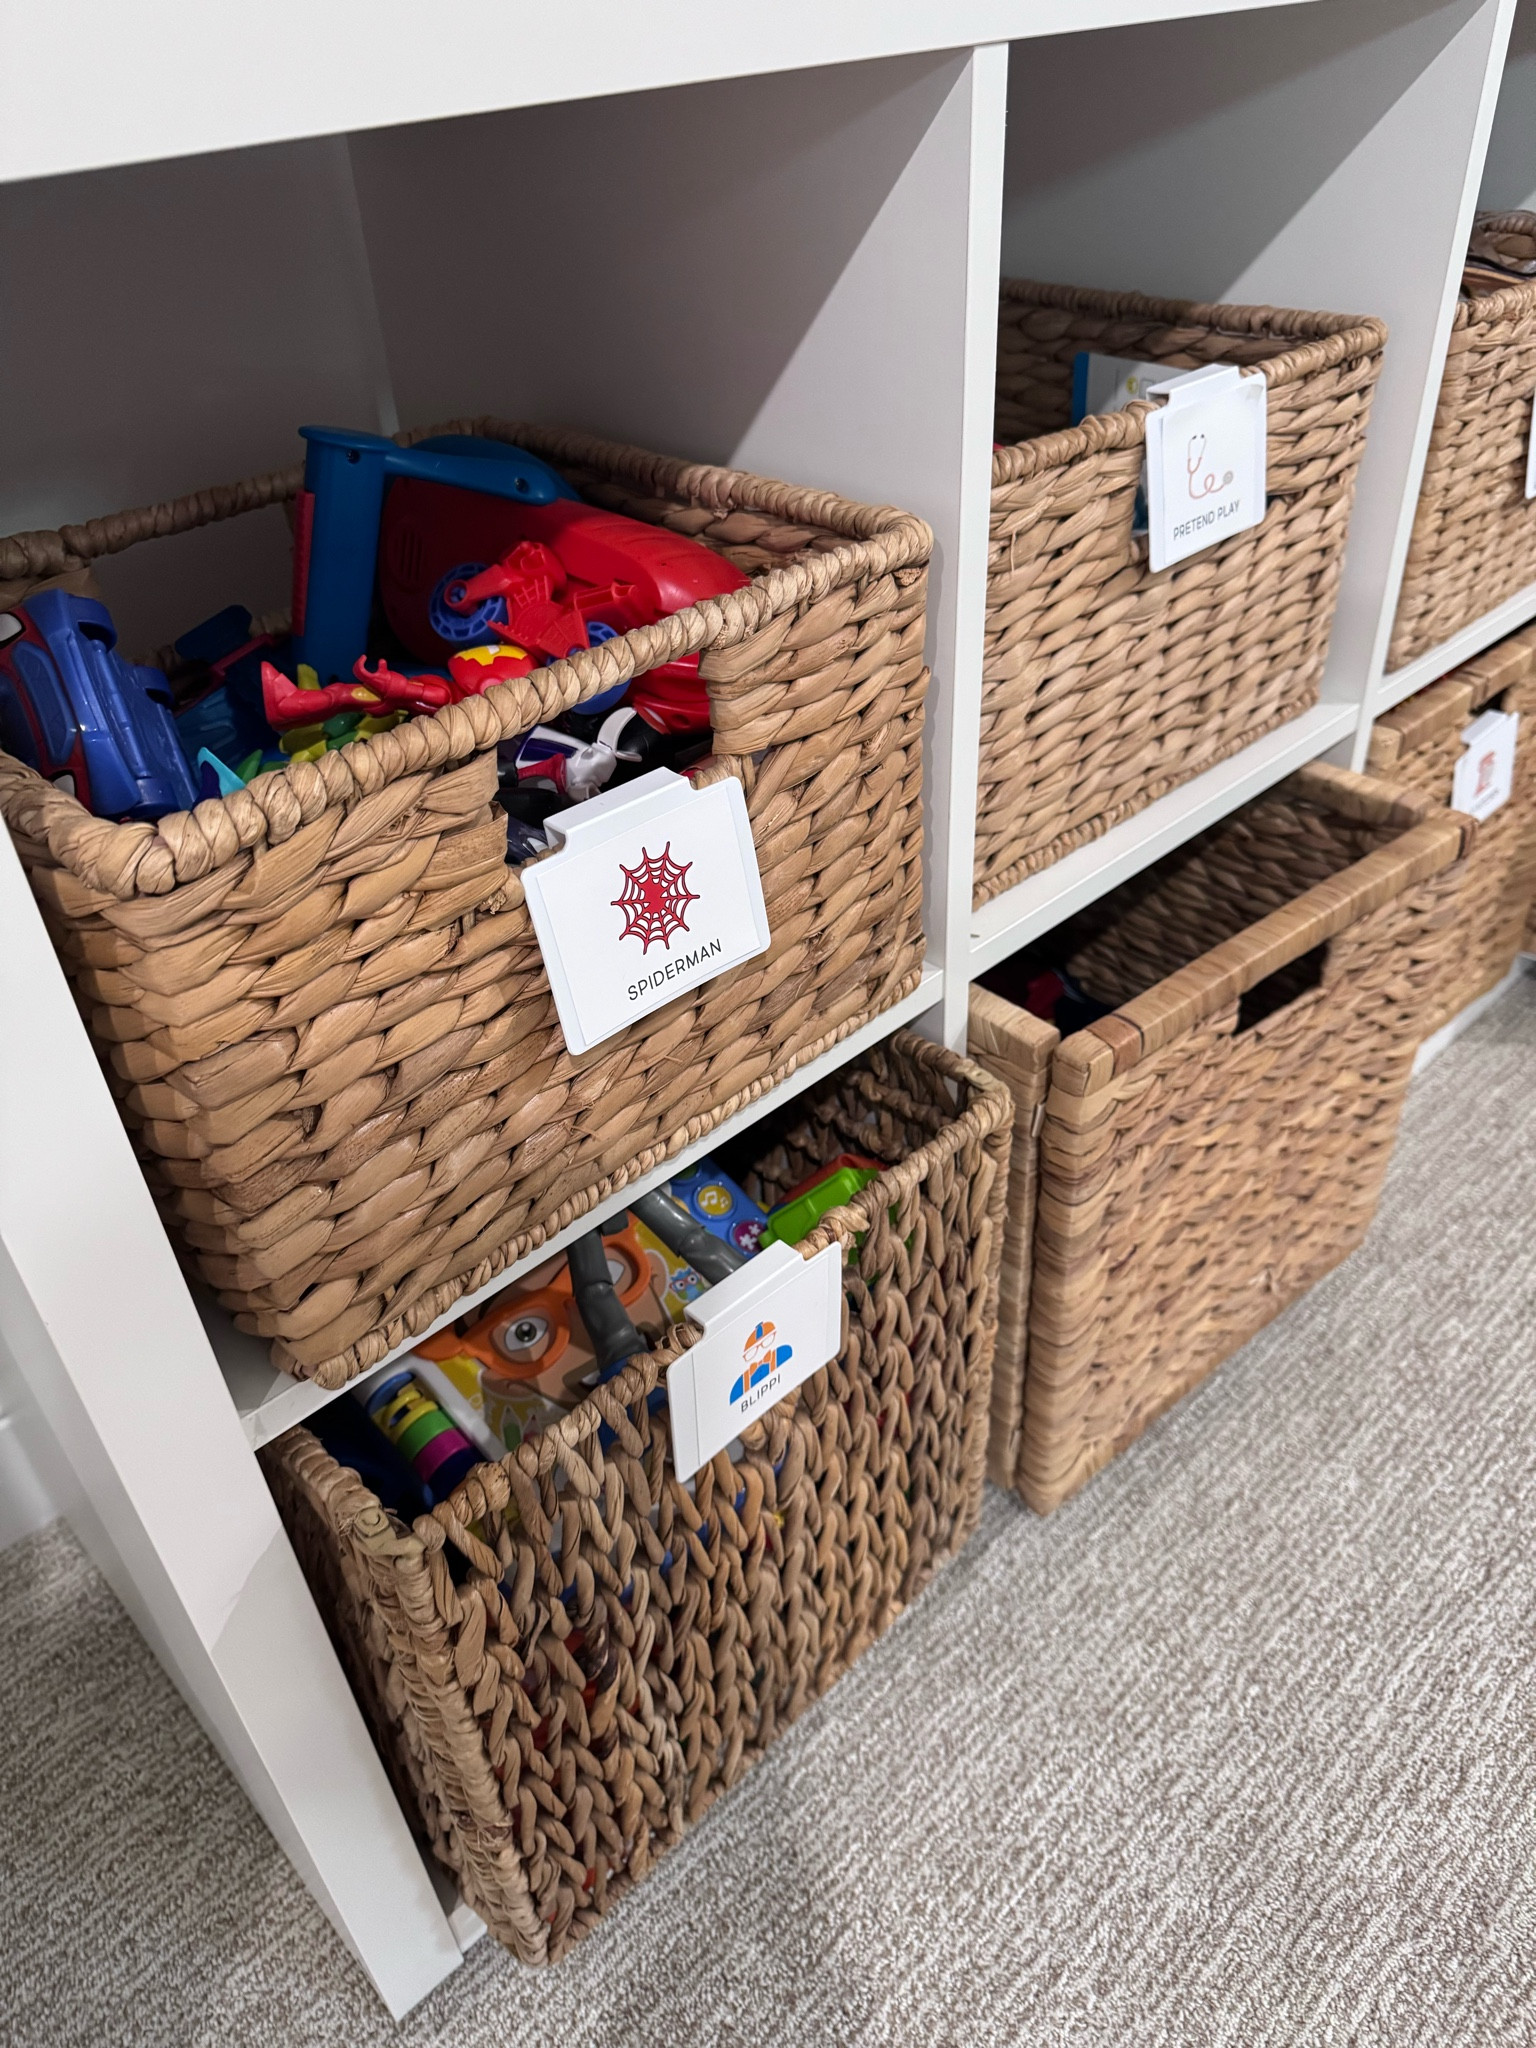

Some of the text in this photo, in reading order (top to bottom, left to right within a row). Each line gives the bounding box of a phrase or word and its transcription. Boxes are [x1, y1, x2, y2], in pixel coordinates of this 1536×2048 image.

[1173, 500, 1240, 540] PRETEND PLAY
[627, 938, 722, 1001] SPIDERMAN
[741, 1373, 781, 1413] BLIPPI
